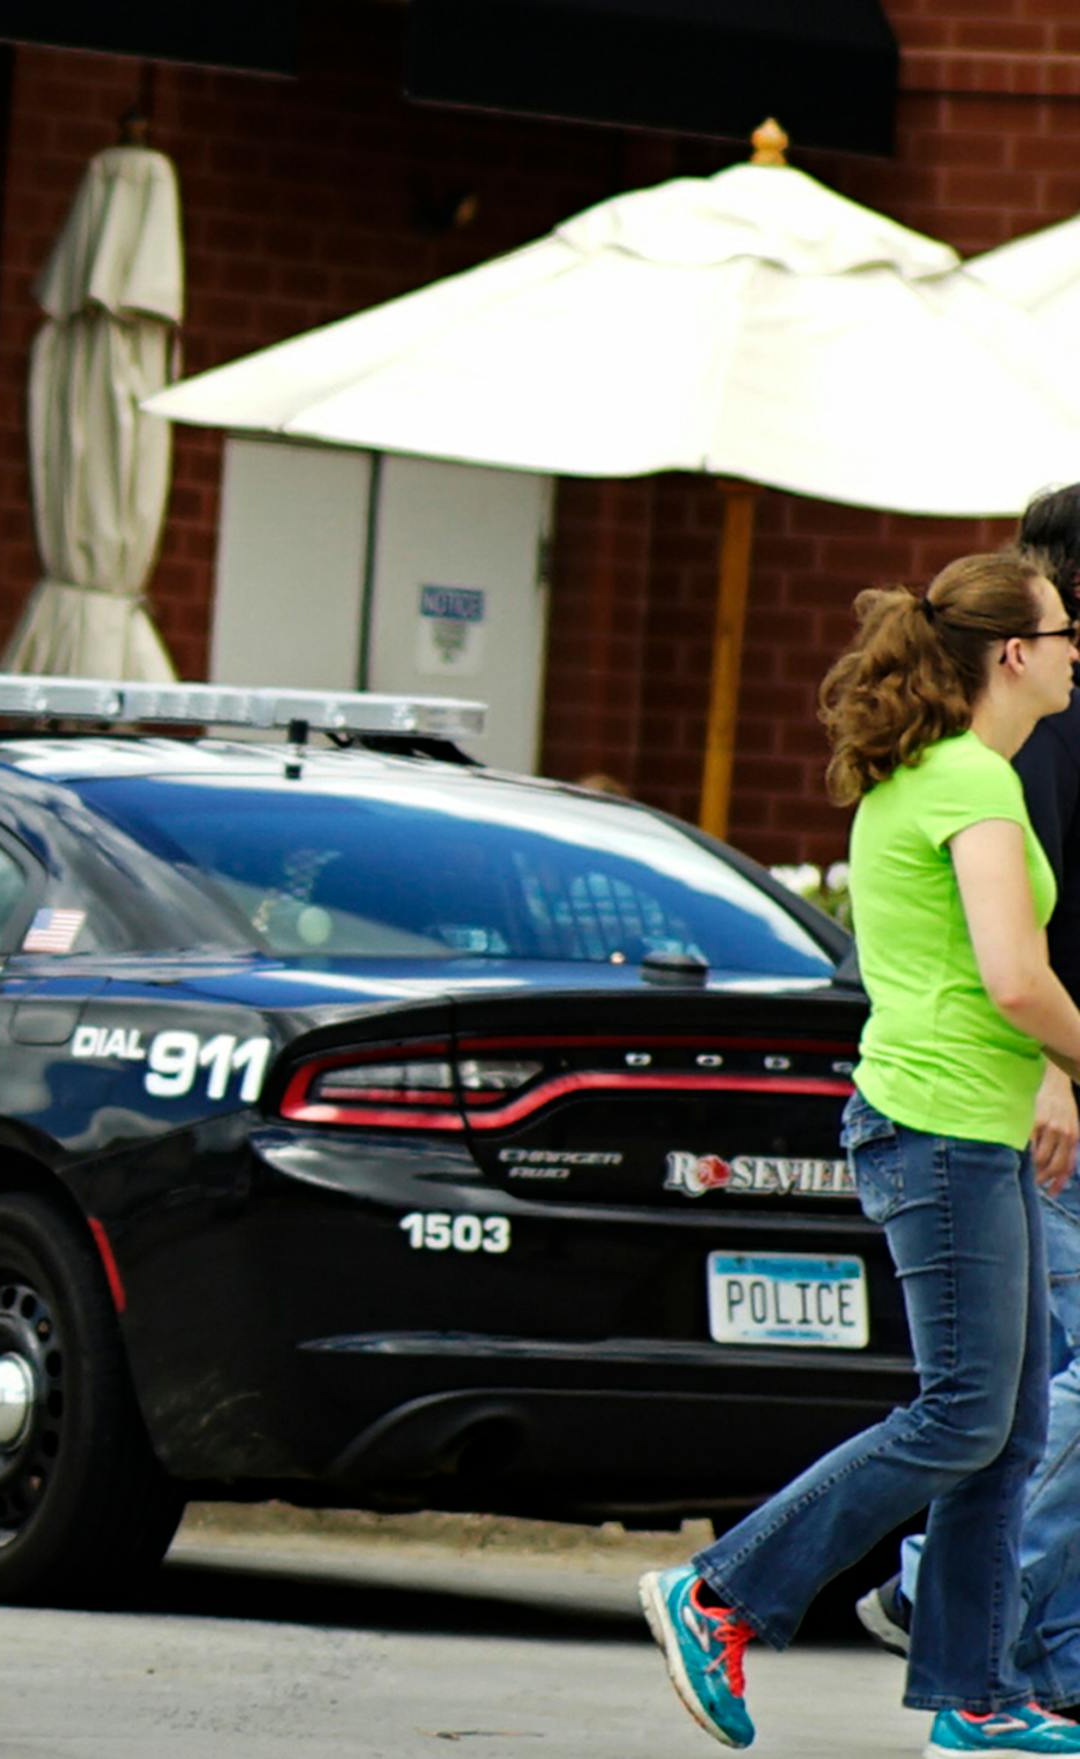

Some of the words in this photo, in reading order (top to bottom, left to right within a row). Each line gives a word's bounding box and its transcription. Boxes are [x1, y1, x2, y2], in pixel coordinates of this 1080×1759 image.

[71, 1026, 146, 1060] DIAL
[144, 1030, 271, 1103] 911
[399, 1214, 512, 1254] 1503
[726, 1279, 856, 1327] POLICE
